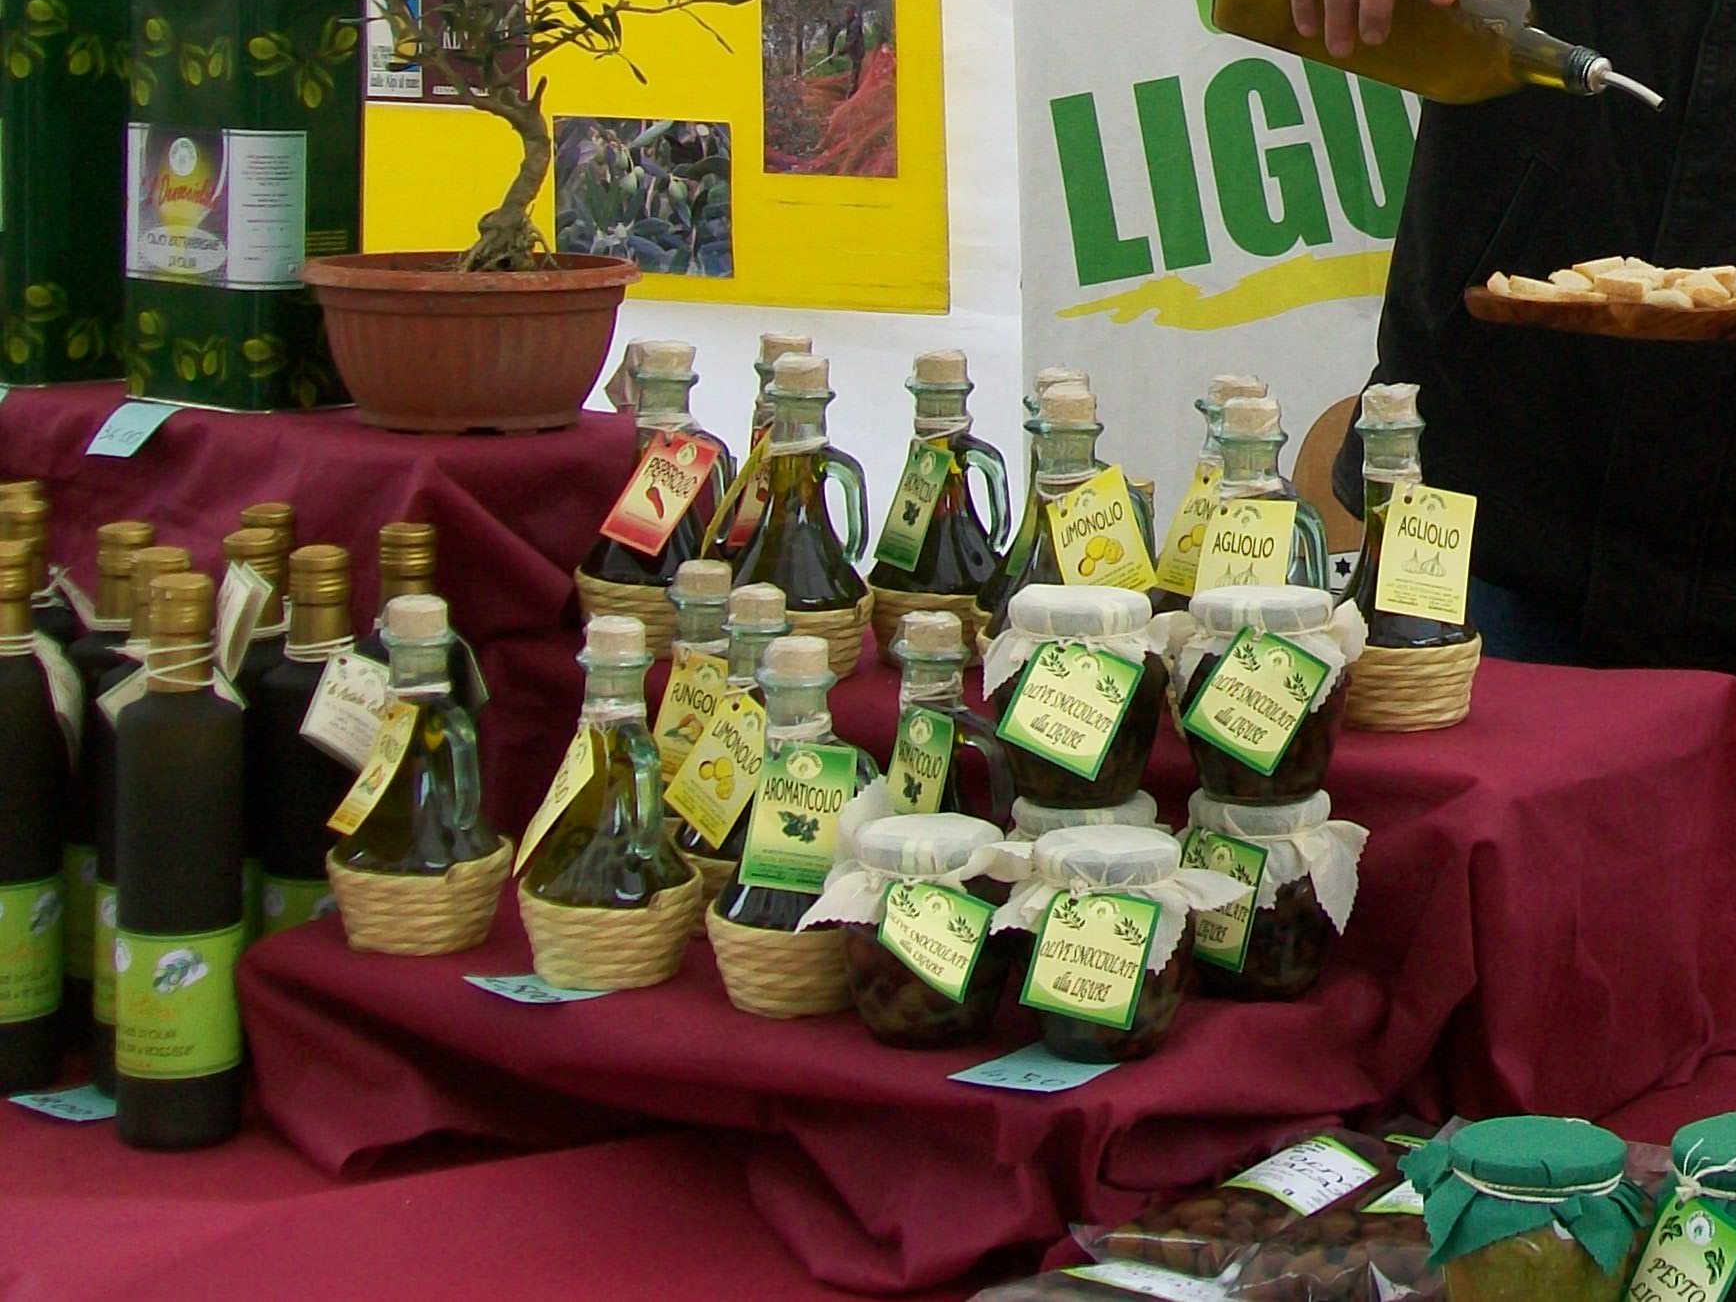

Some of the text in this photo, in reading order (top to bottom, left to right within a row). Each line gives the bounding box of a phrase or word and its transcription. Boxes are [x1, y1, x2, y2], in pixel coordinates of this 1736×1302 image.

[1060, 501, 1124, 549] LIMONOLIO
[1397, 515, 1460, 550] AGLIOLIO
[1212, 531, 1275, 559] AGLIOLIO
[1023, 681, 1114, 733] OLIVE SNOCCIOLATE
[1211, 674, 1296, 732] OLIVE SNOCCIOLATE
[712, 720, 762, 776] LIMONOLIO
[1047, 721, 1087, 750] LIGURE
[1234, 716, 1268, 745] LIGURE
[762, 777, 843, 814] AROMATICOLIO
[1040, 939, 1141, 980] OLIVE SNOCCIOLATE
[1070, 978, 1113, 1003] LIGURE
